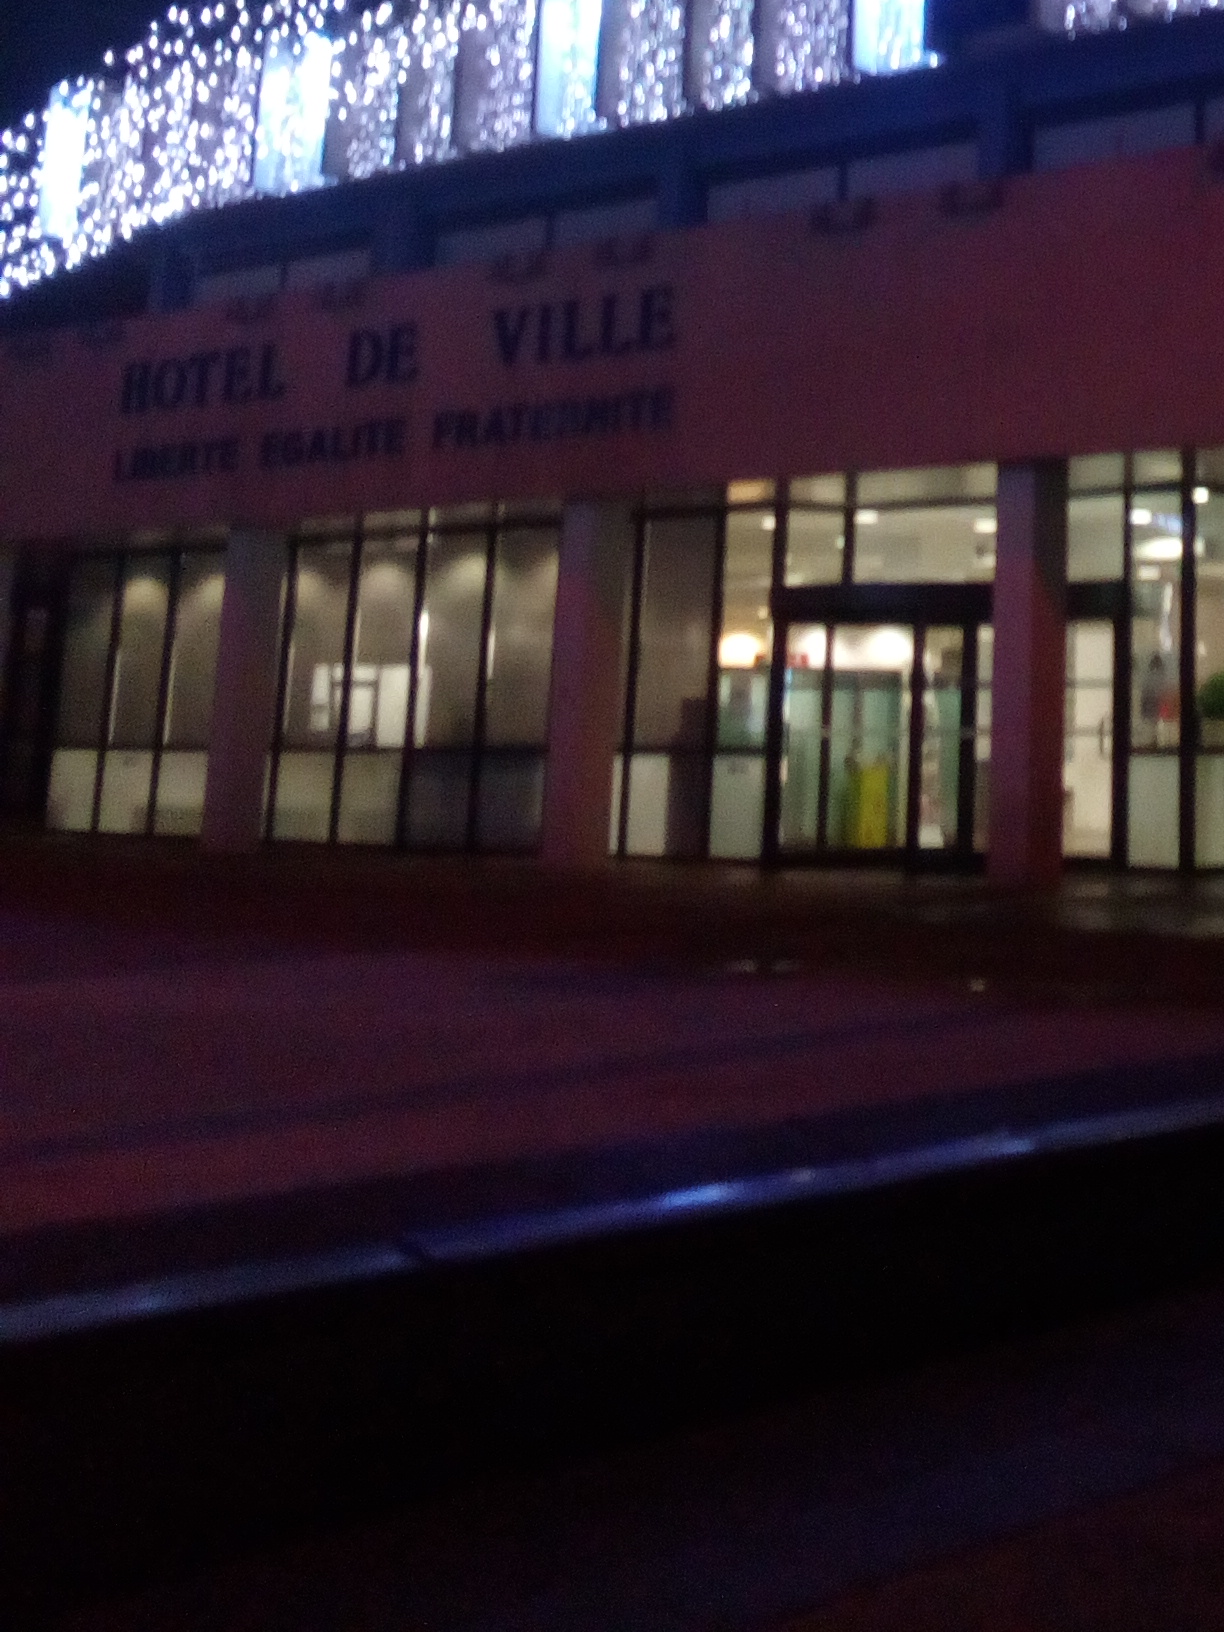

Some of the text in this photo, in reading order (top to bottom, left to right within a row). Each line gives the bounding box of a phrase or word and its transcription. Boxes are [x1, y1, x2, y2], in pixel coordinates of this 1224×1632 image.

[120, 286, 677, 414] HOTEL DE VILLE
